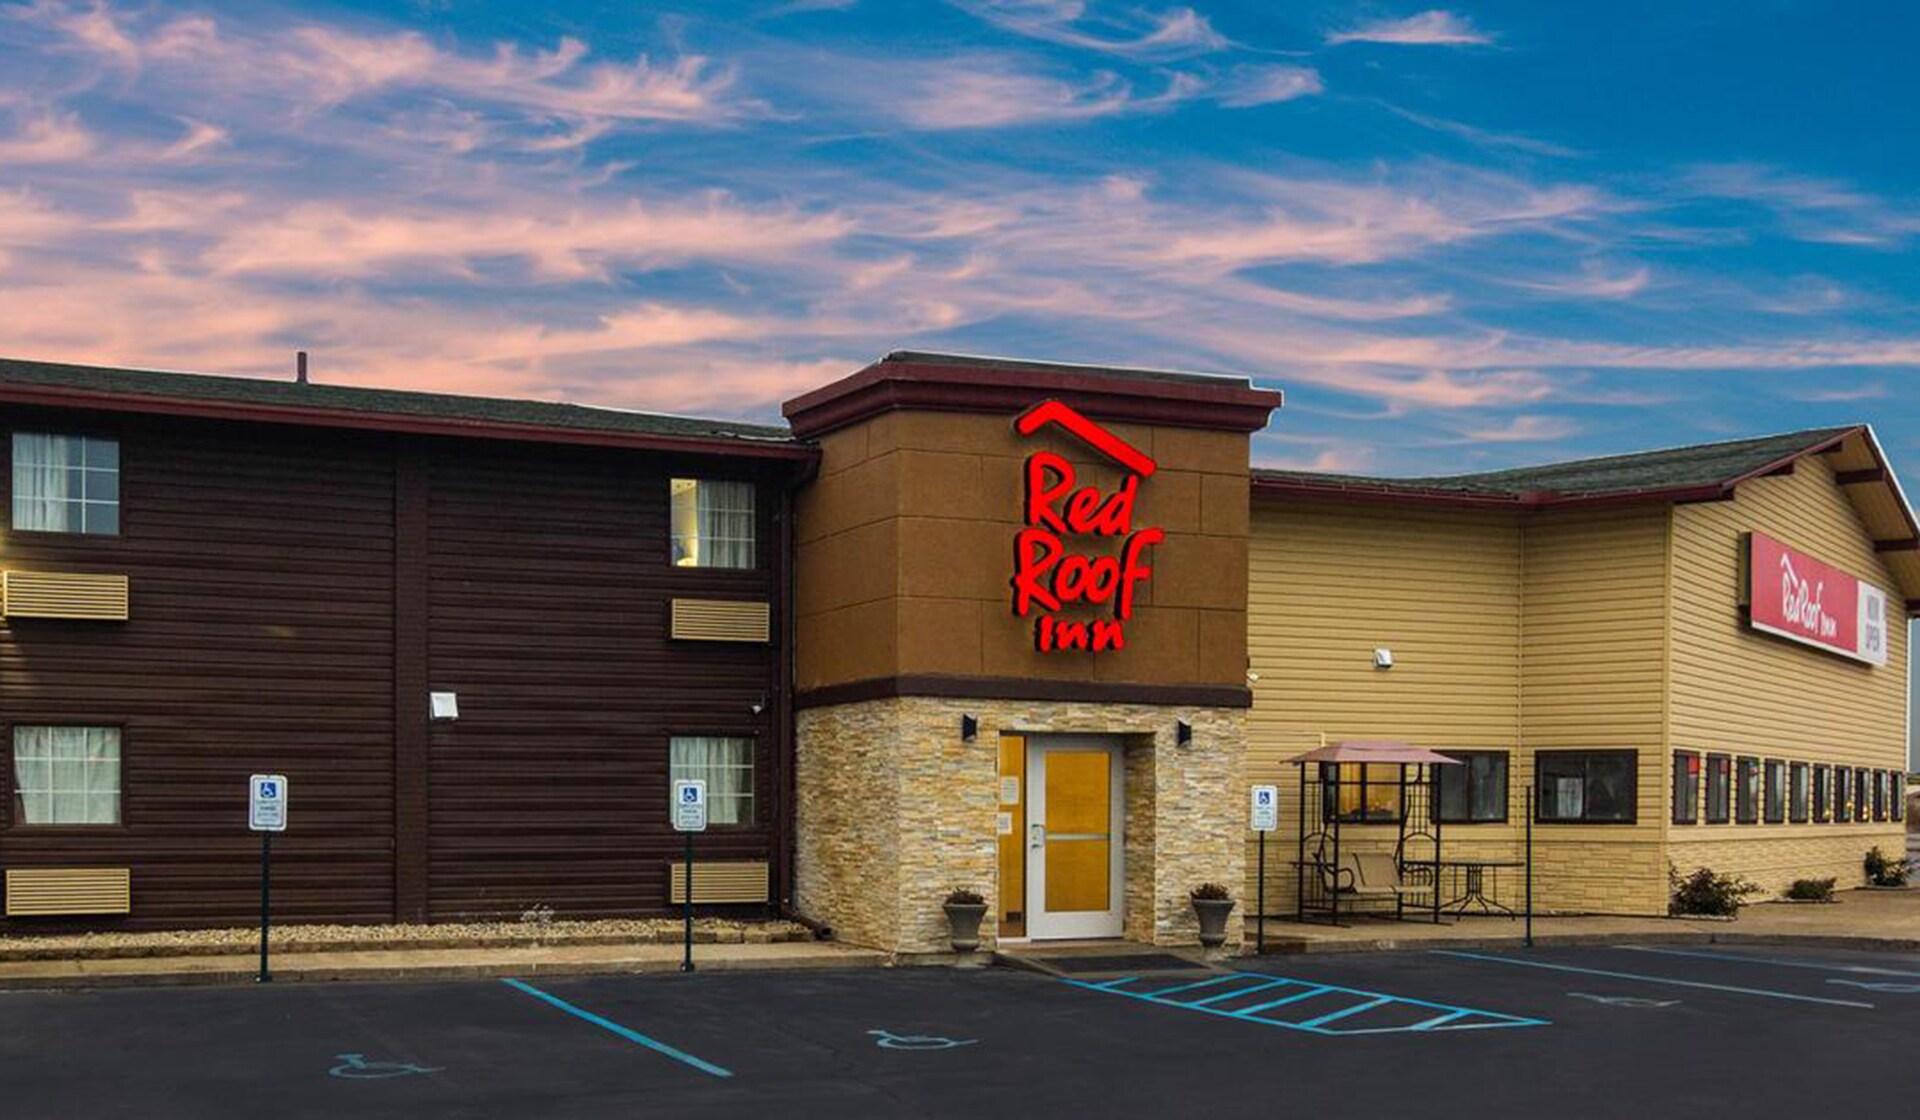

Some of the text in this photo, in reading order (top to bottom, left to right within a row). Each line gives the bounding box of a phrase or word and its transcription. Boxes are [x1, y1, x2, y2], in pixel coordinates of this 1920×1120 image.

[1025, 451, 1138, 536] Red
[1011, 526, 1166, 622] Roof
[1783, 572, 1800, 622] Red
[1800, 579, 1823, 634] Roof
